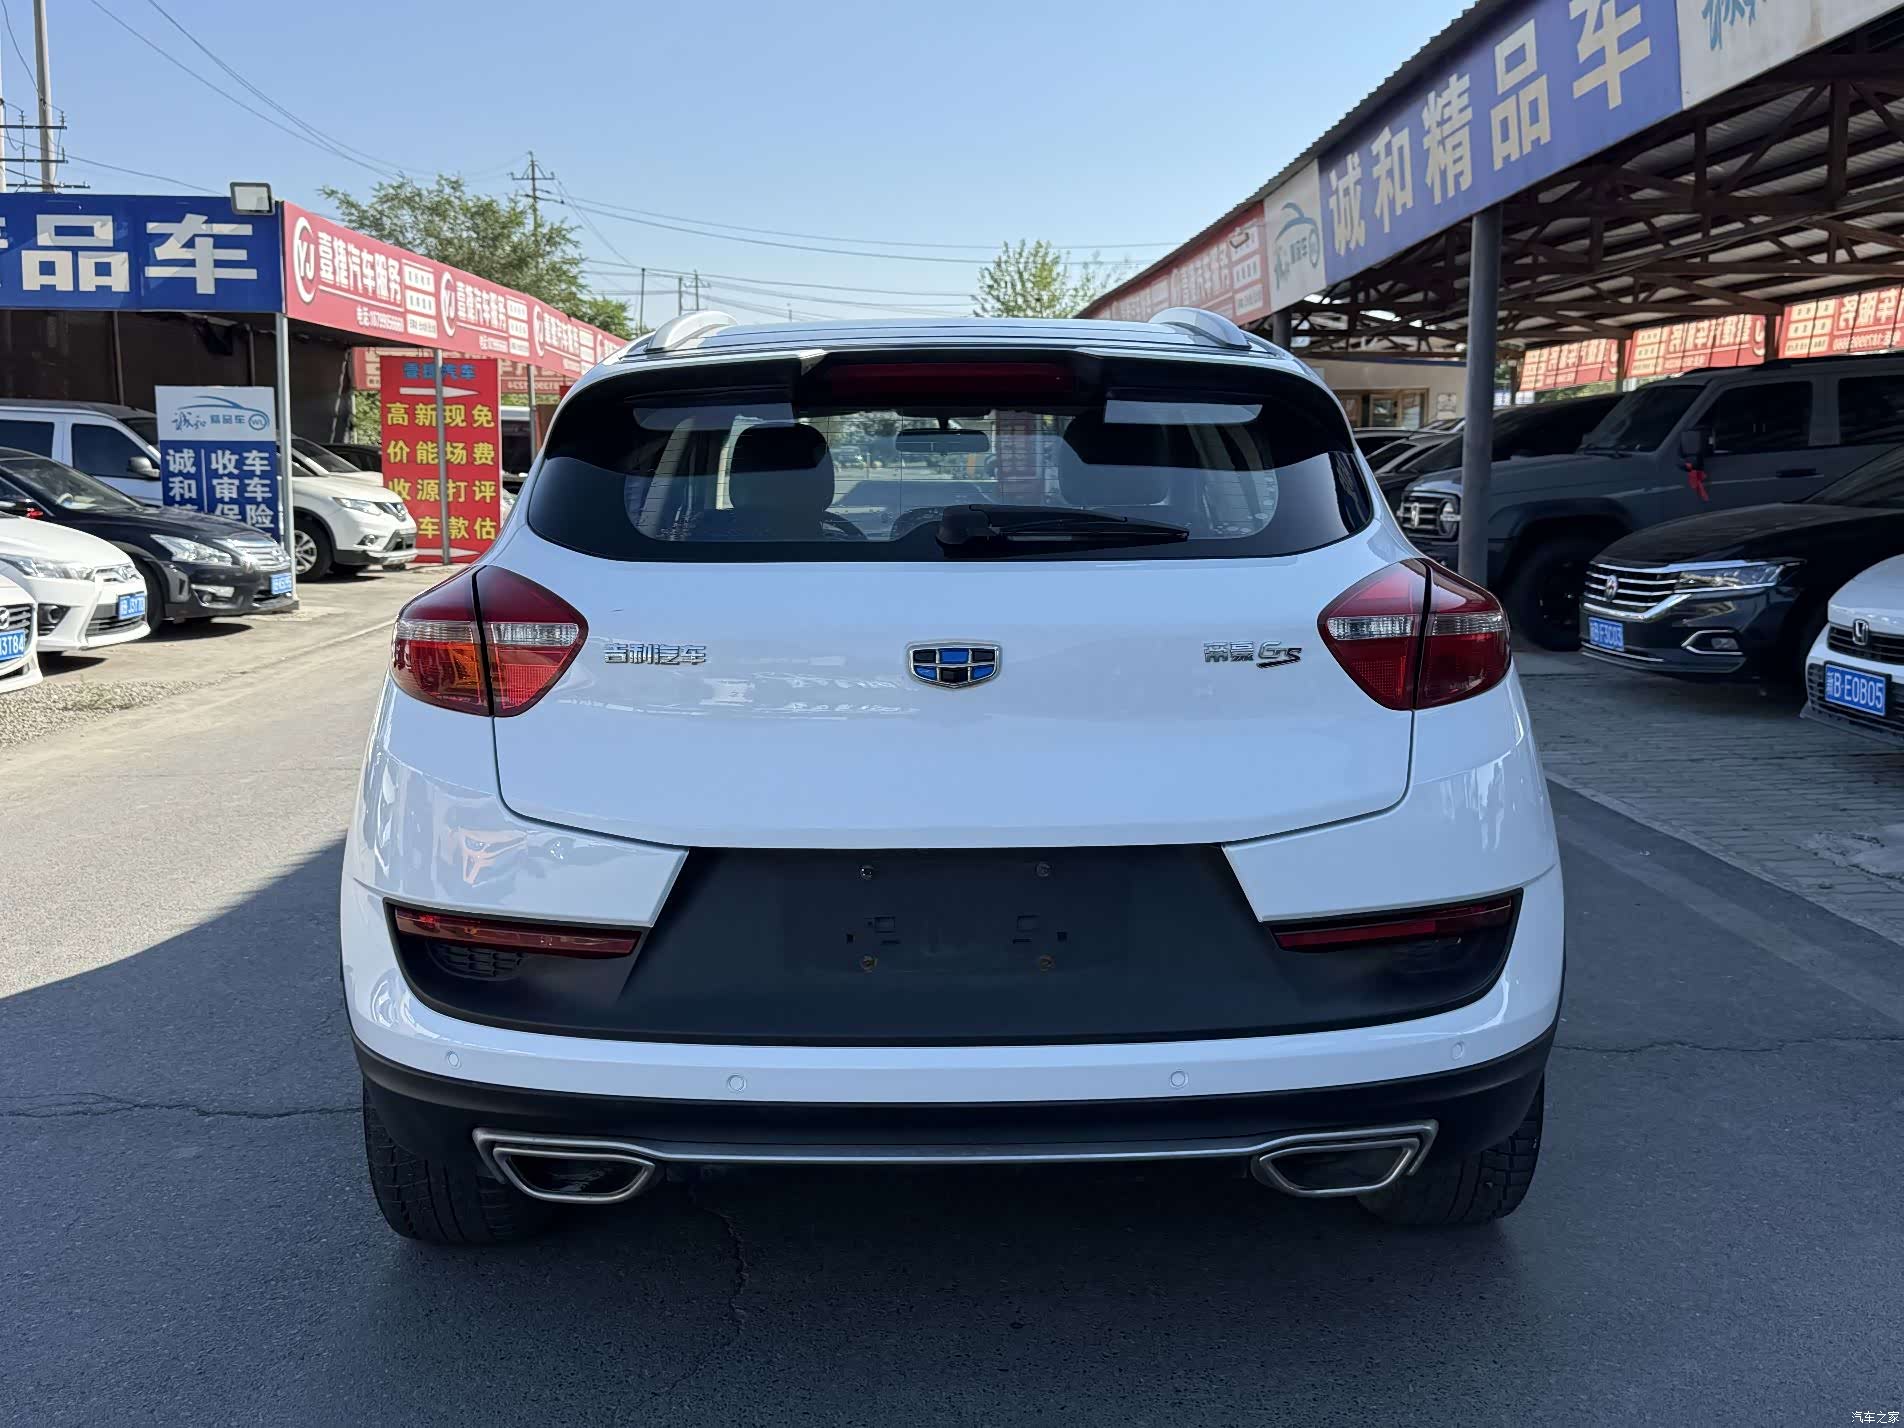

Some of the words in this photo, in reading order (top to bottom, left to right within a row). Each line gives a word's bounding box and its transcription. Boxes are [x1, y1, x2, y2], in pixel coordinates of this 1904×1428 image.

[1328, 0, 1652, 256] 诚和精品车
[210, 449, 271, 475] 收车
[386, 402, 411, 501] 高价收
[166, 448, 198, 511] 诚和
[212, 476, 273, 502] 审车
[0, 634, 24, 657] 3T84
[604, 642, 706, 665] 吉利汽车
[1204, 641, 1254, 662] 帝豪
